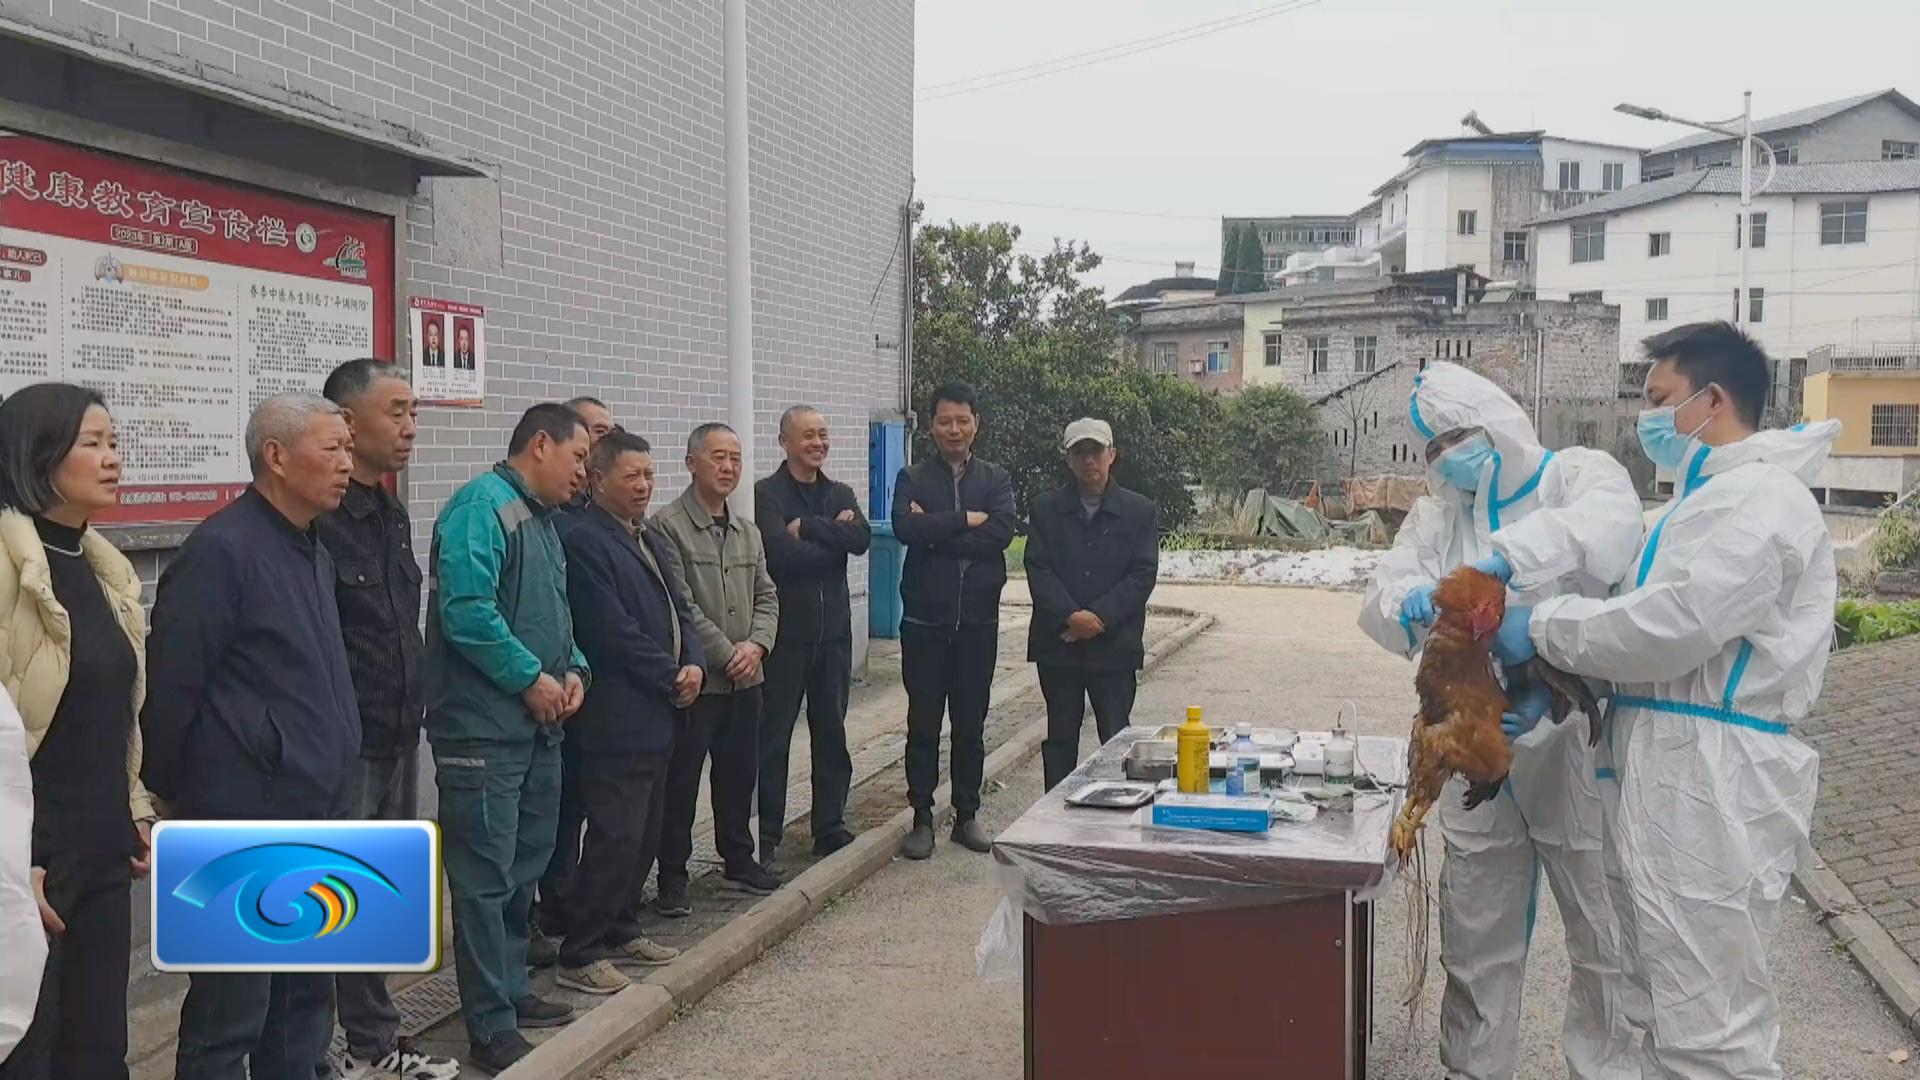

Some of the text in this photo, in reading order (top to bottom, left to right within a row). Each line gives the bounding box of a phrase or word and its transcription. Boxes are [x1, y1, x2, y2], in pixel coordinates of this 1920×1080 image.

[0, 160, 289, 247] 健康教育宣传栏
